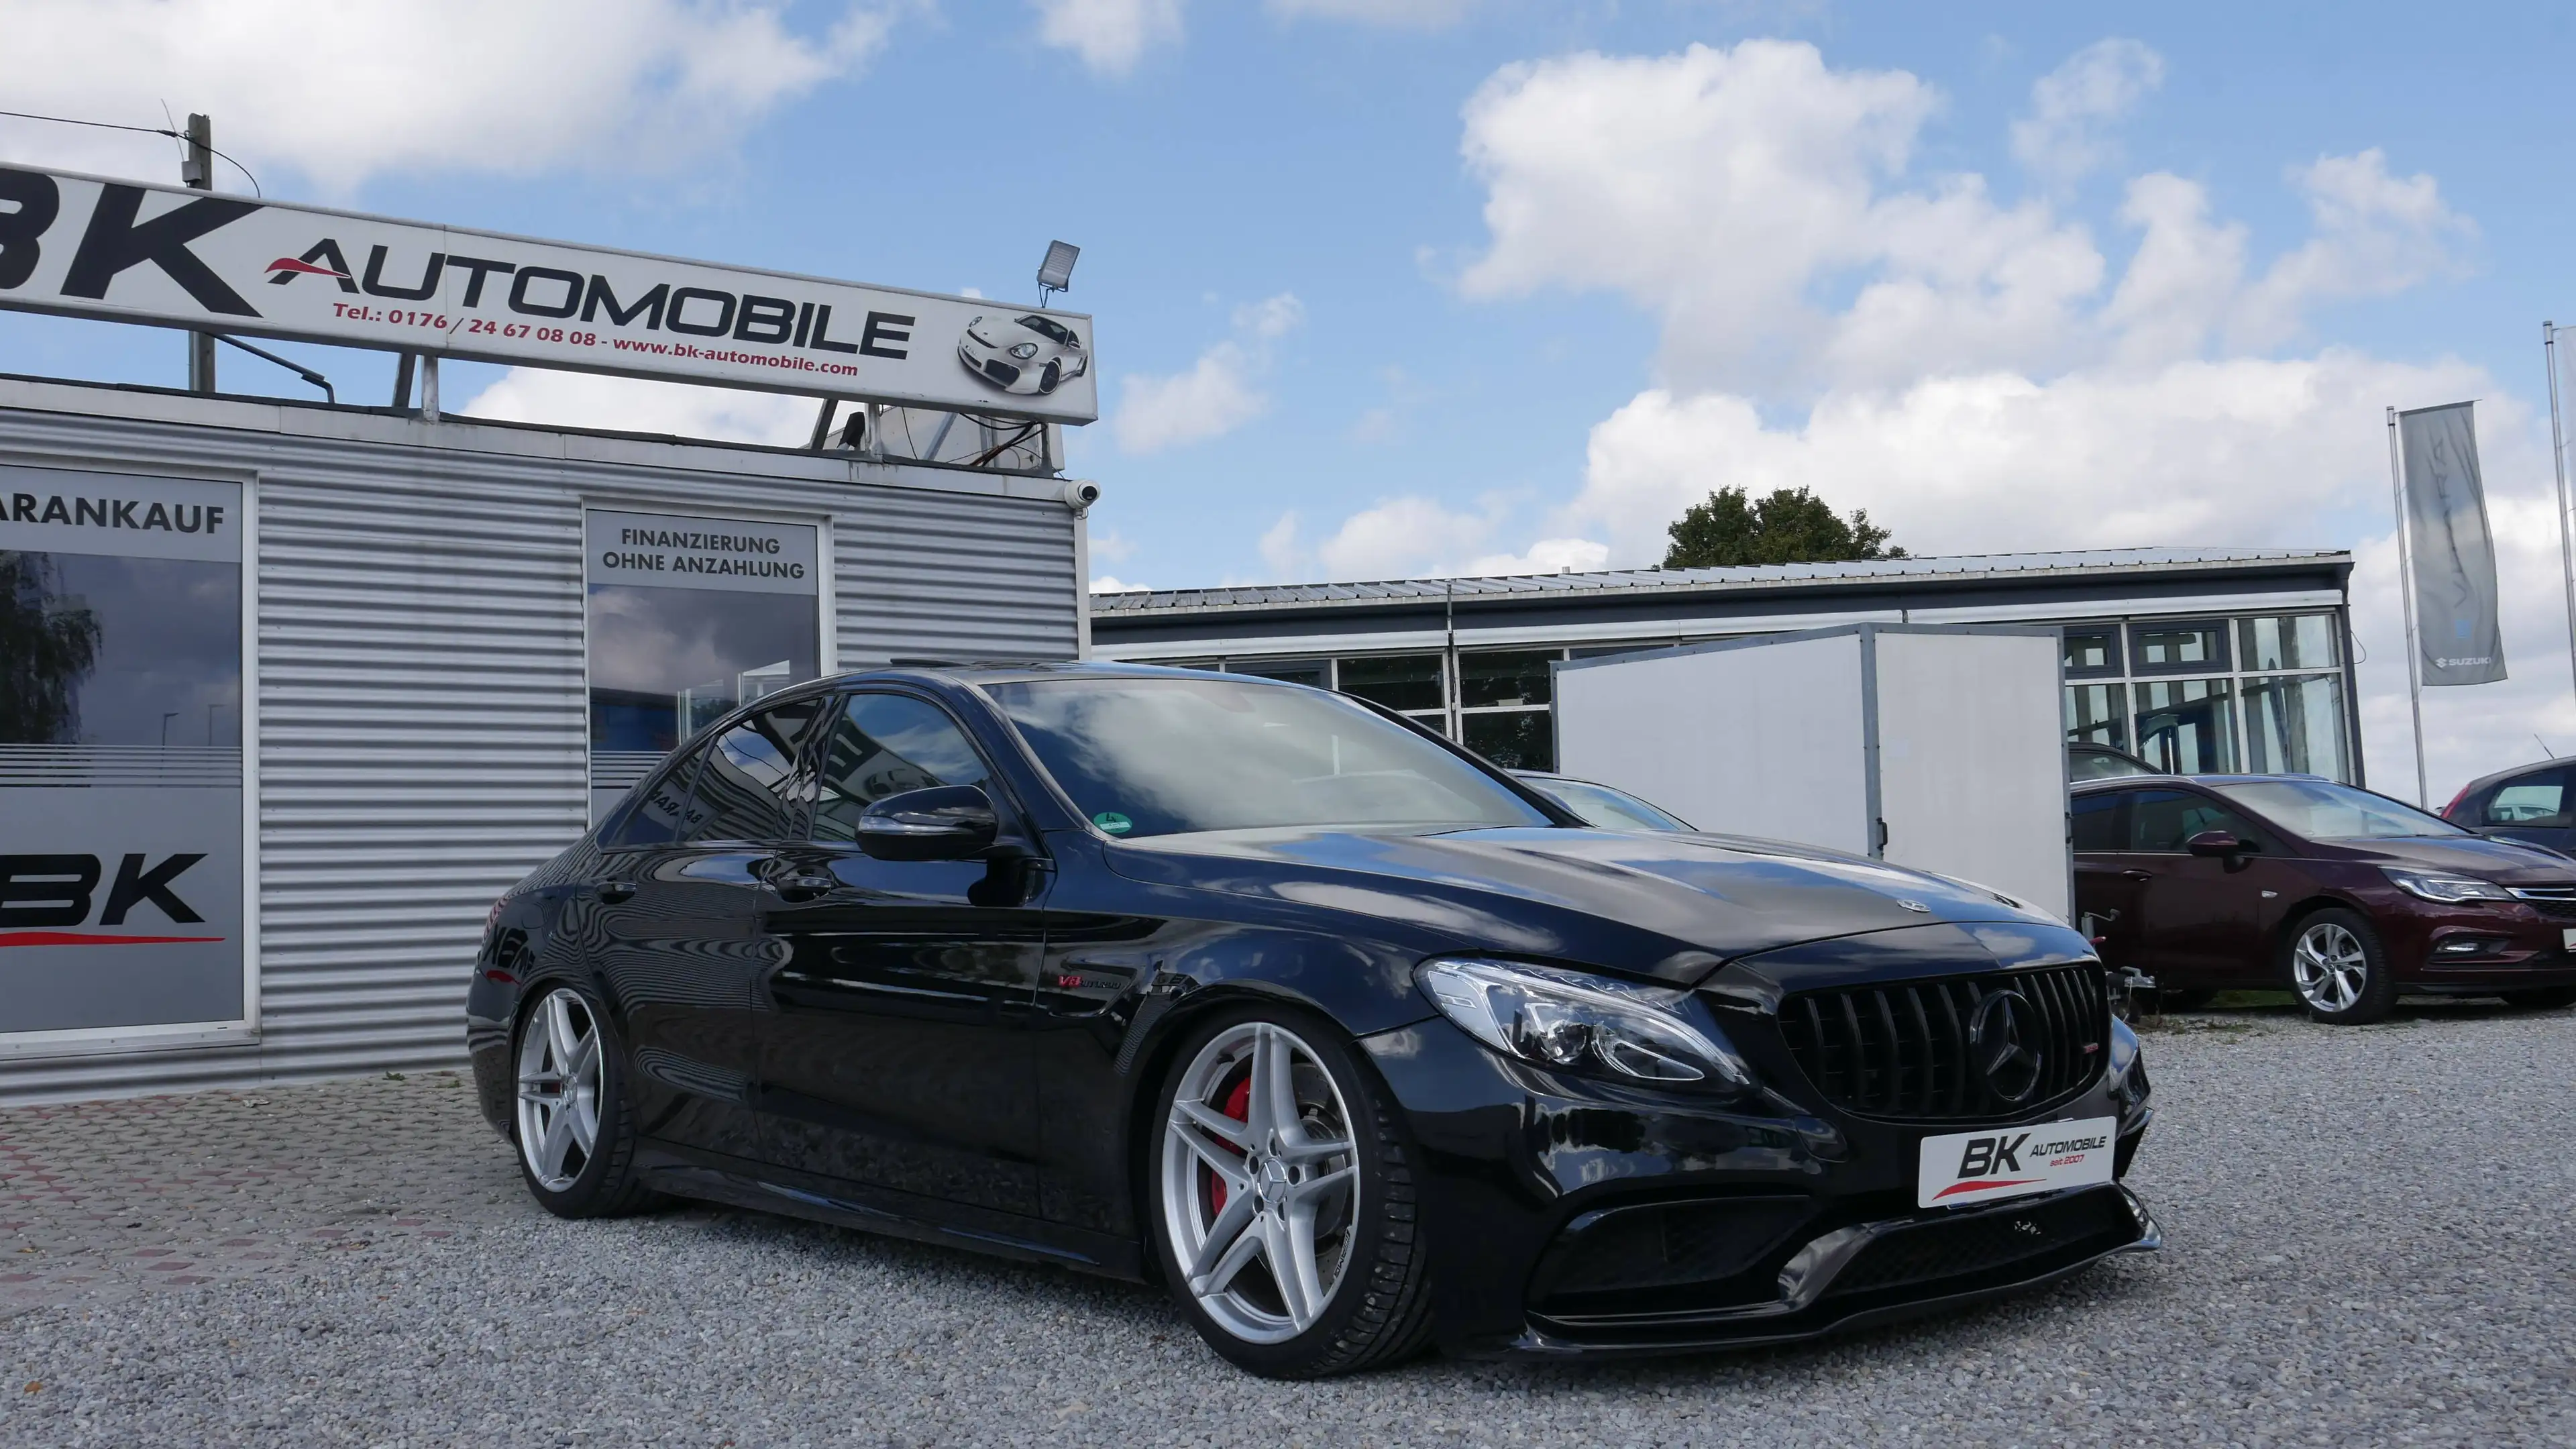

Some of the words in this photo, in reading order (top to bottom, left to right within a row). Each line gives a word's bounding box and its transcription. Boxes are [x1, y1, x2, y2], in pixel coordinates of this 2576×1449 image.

[265, 238, 916, 360] AUTOMOBILE
[333, 303, 382, 322] Tel.:
[388, 310, 447, 329] 0176
[468, 319, 496, 334] 24
[503, 323, 531, 338] 67
[537, 327, 563, 342] 08
[570, 331, 596, 345] 08
[613, 338, 858, 376] www.bk-automobile.com
[0, 493, 223, 534] RANKAUF
[622, 529, 780, 554] FINANZIERUNG
[603, 552, 665, 570] OHNE
[673, 556, 804, 579] ANZAHLUNG
[2449, 657, 2491, 665] SUZUKI
[0, 853, 209, 927] BK
[1957, 1132, 2031, 1179] BK
[2029, 1136, 2107, 1157] AUTOMOBILE
[2049, 1157, 2063, 1167] seit
[2063, 1155, 2084, 1165] 2007
